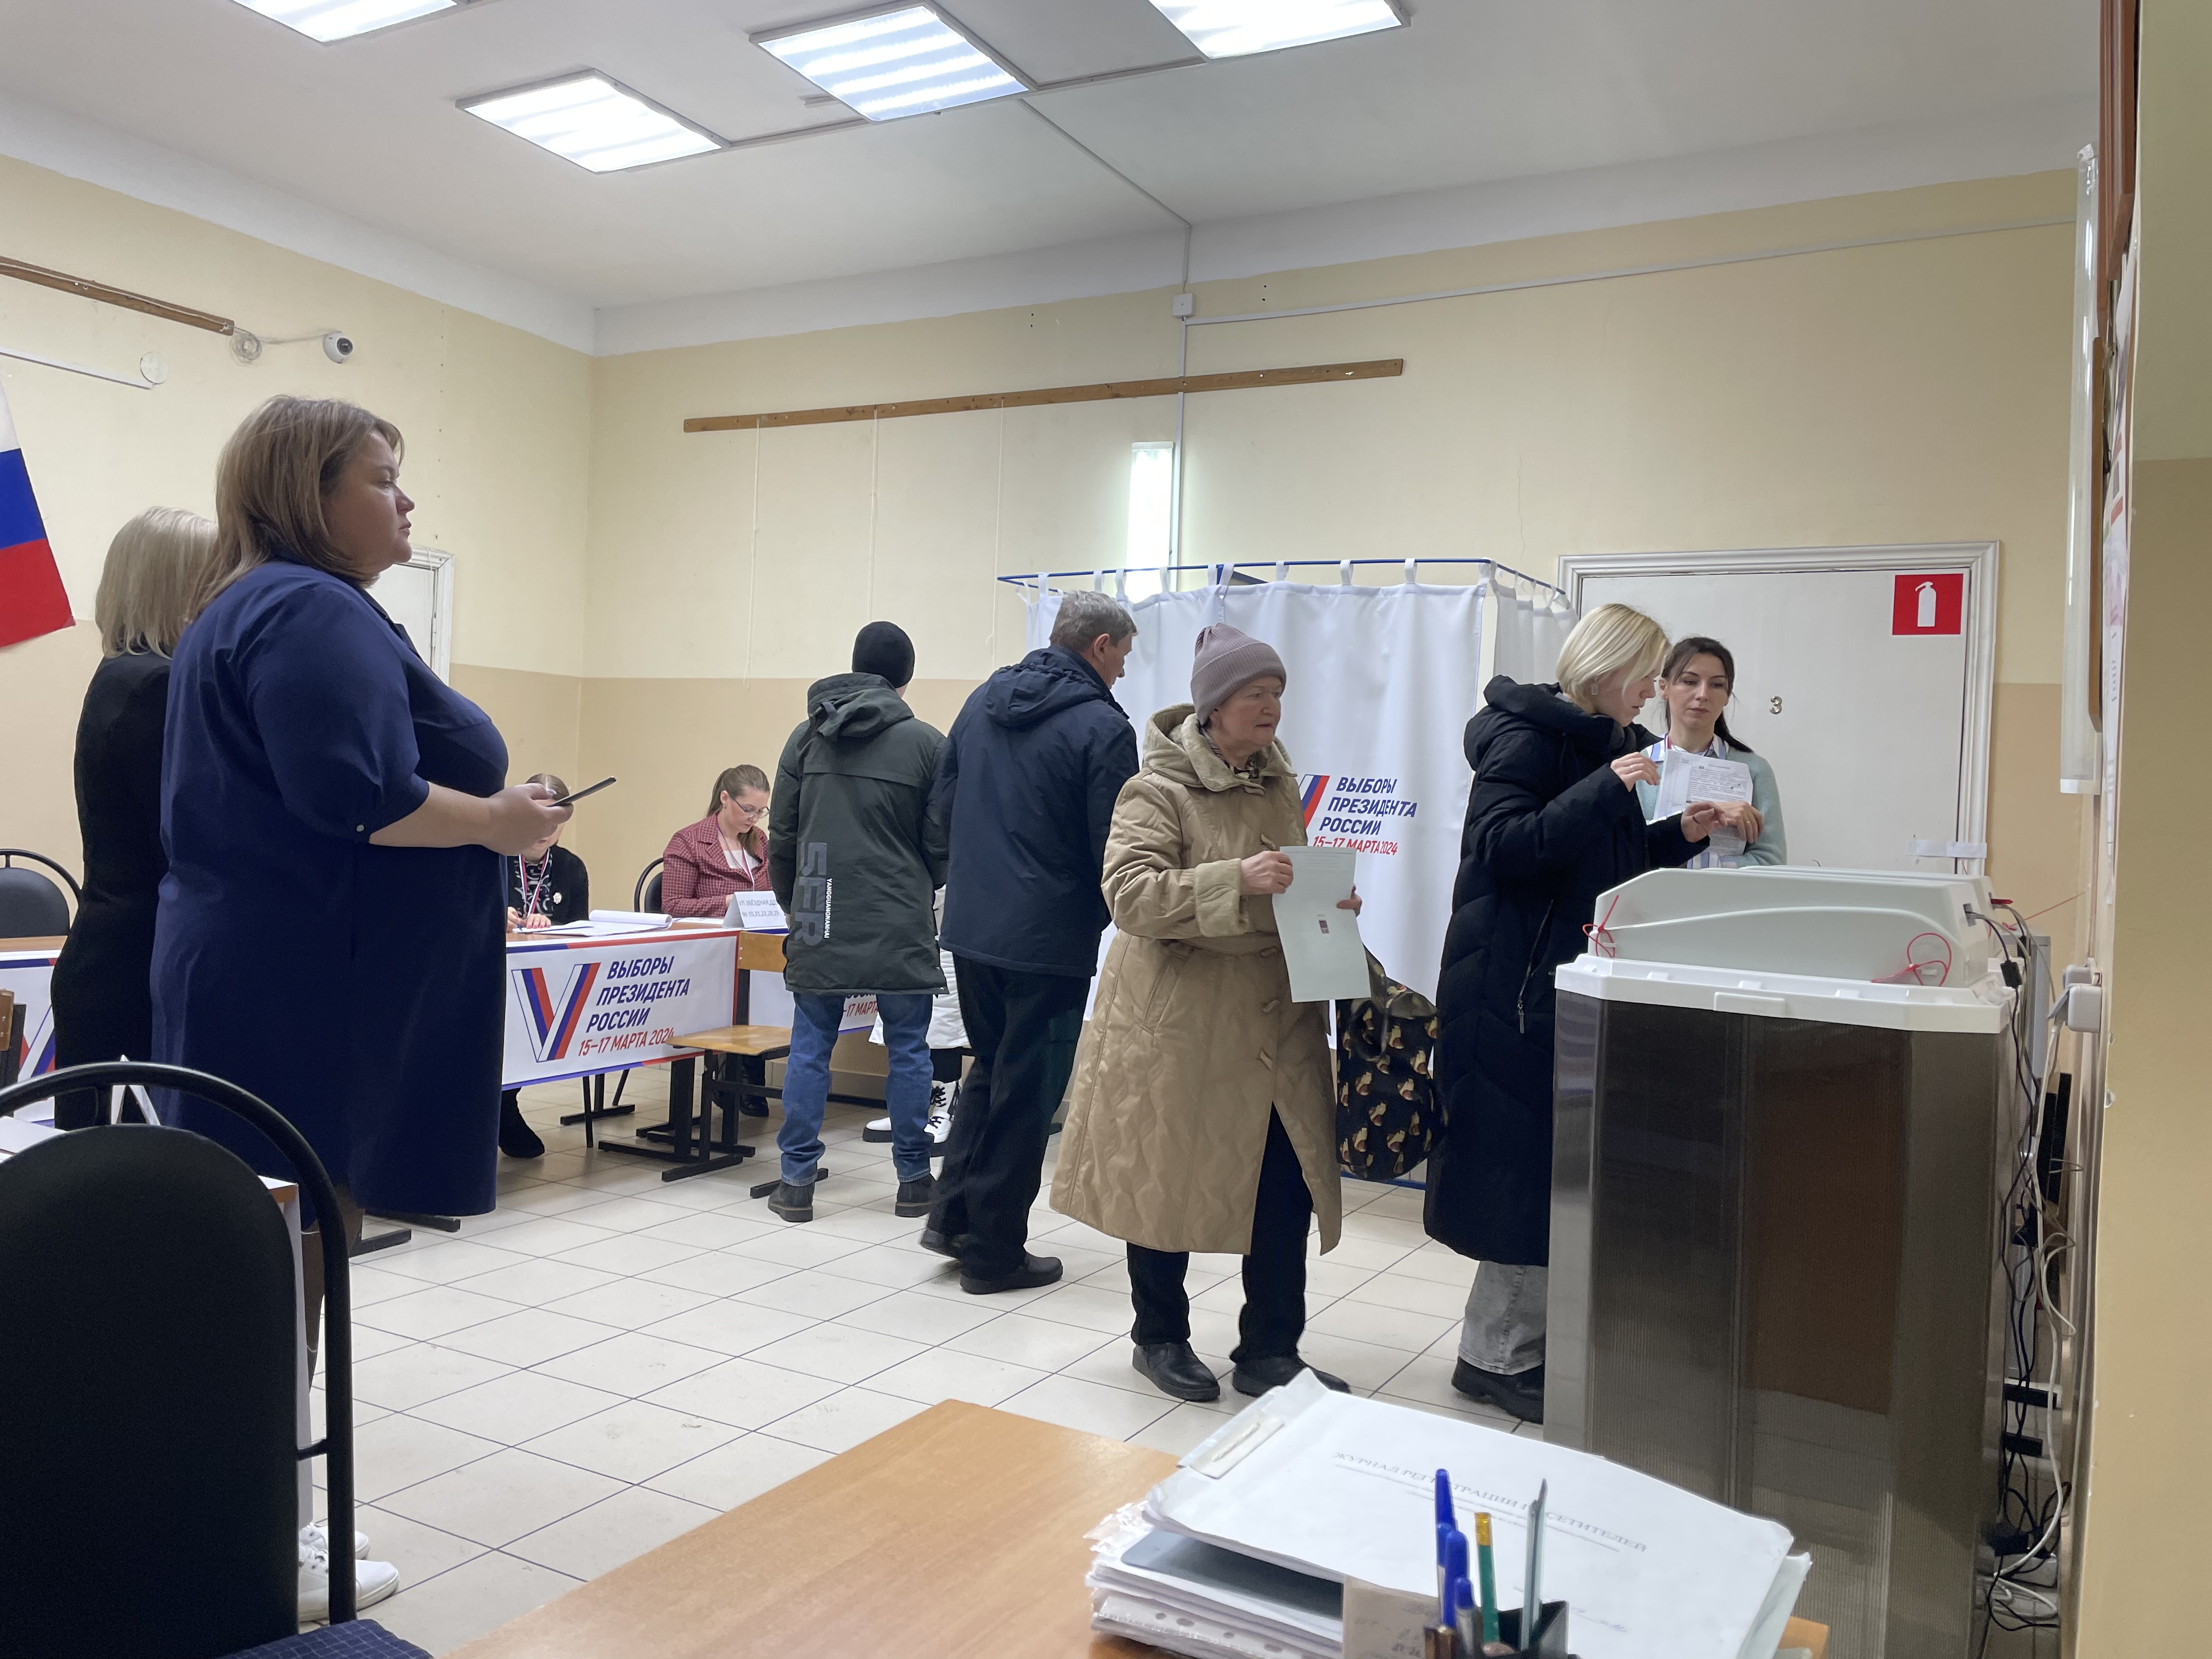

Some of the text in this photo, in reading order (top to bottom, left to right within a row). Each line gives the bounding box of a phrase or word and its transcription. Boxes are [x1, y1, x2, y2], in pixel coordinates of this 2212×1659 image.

[1770, 696, 1782, 714] 3
[1336, 777, 1397, 793] ВЫБОРЫ
[1328, 797, 1417, 817] ПРЕЗИДЕНТА
[1319, 817, 1381, 835] РОССИИ
[1346, 838, 1380, 854] МАРТА
[1380, 841, 1398, 855] 2024
[607, 956, 675, 980] ВЫБОРЫ
[596, 978, 690, 1006] ПРЕЗИДЕНТА
[586, 1007, 651, 1033] РОССИИ
[610, 1031, 648, 1052] МАРТА
[1334, 1452, 1400, 1474] ЖУРНАЛ
[1402, 1469, 1518, 1507] РЕГТРАЦИИ
[1522, 1504, 1647, 1552] СЕТИТЕЛЕЙ
